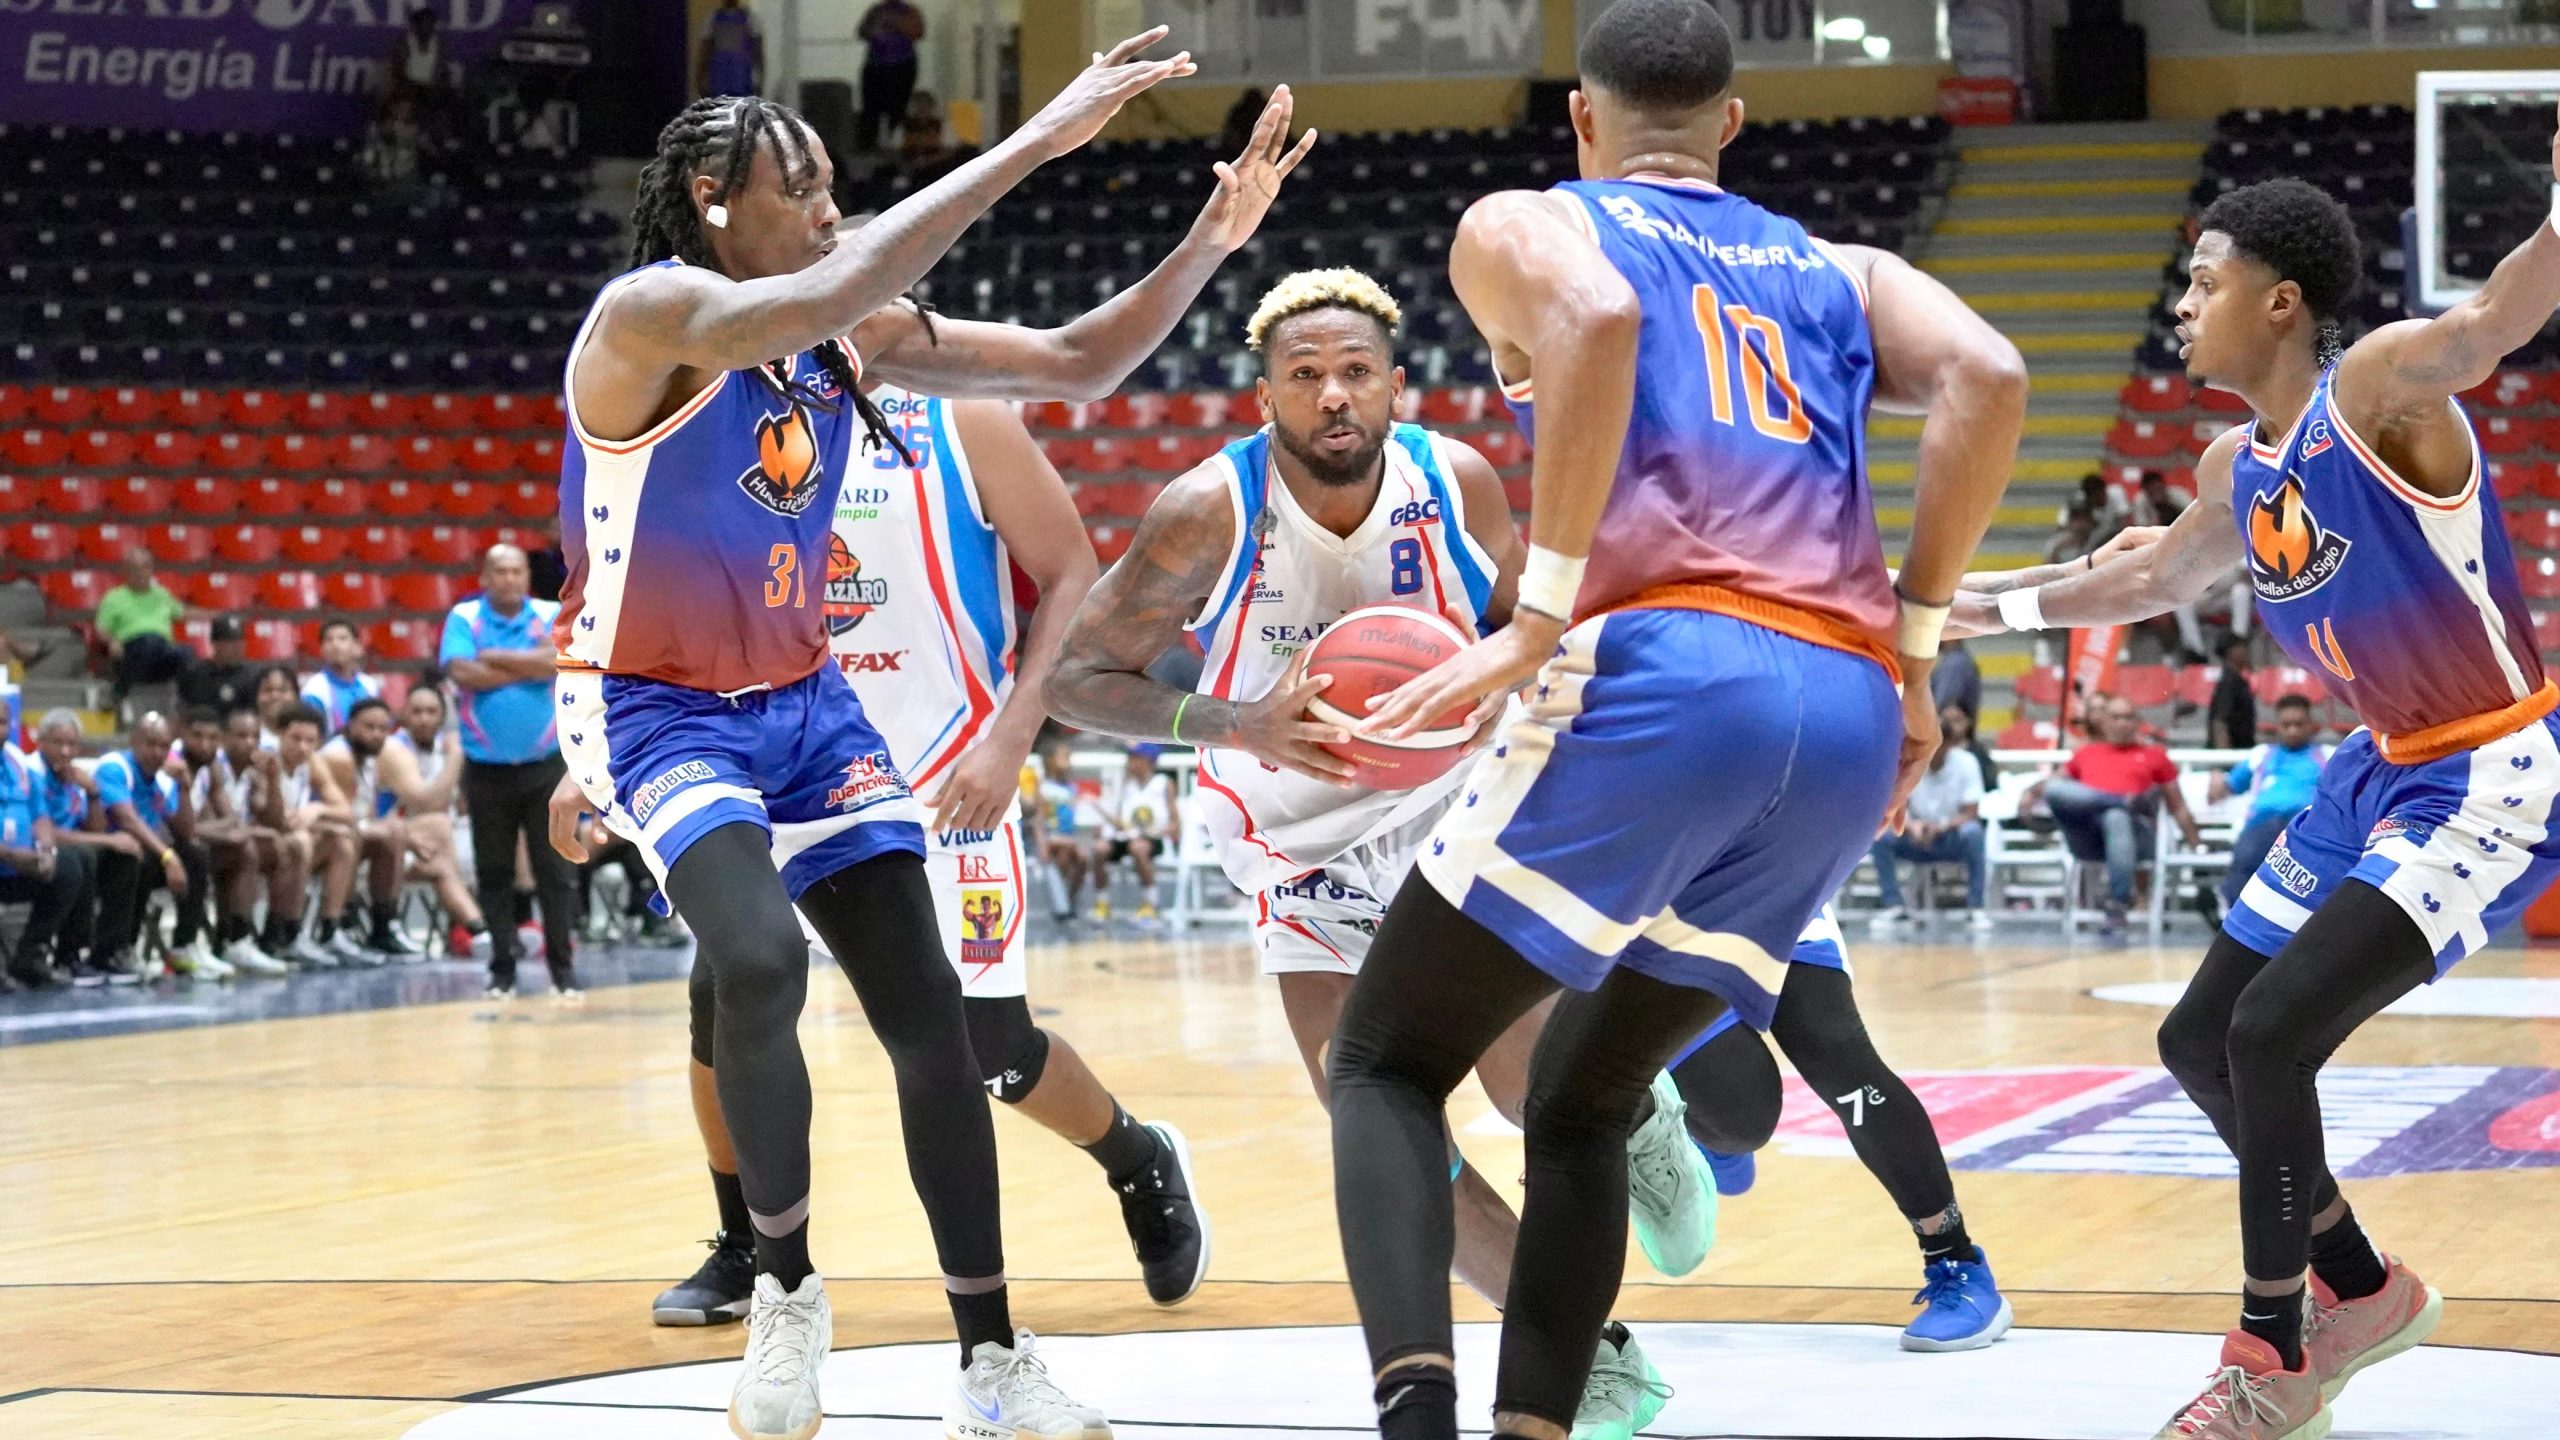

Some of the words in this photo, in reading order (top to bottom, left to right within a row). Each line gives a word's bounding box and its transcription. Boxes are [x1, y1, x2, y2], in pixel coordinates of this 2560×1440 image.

[25, 30, 256, 100] Energía
[1692, 283, 1814, 444] 10
[881, 397, 927, 414] GBC
[834, 506, 878, 521] impia
[1390, 498, 1440, 527] GBC
[764, 543, 806, 608] 31
[1390, 537, 1424, 596] 8
[2292, 569, 2317, 590] del
[2311, 546, 2339, 578] Siglo
[823, 578, 888, 605] AZARO
[835, 650, 904, 673] FAX
